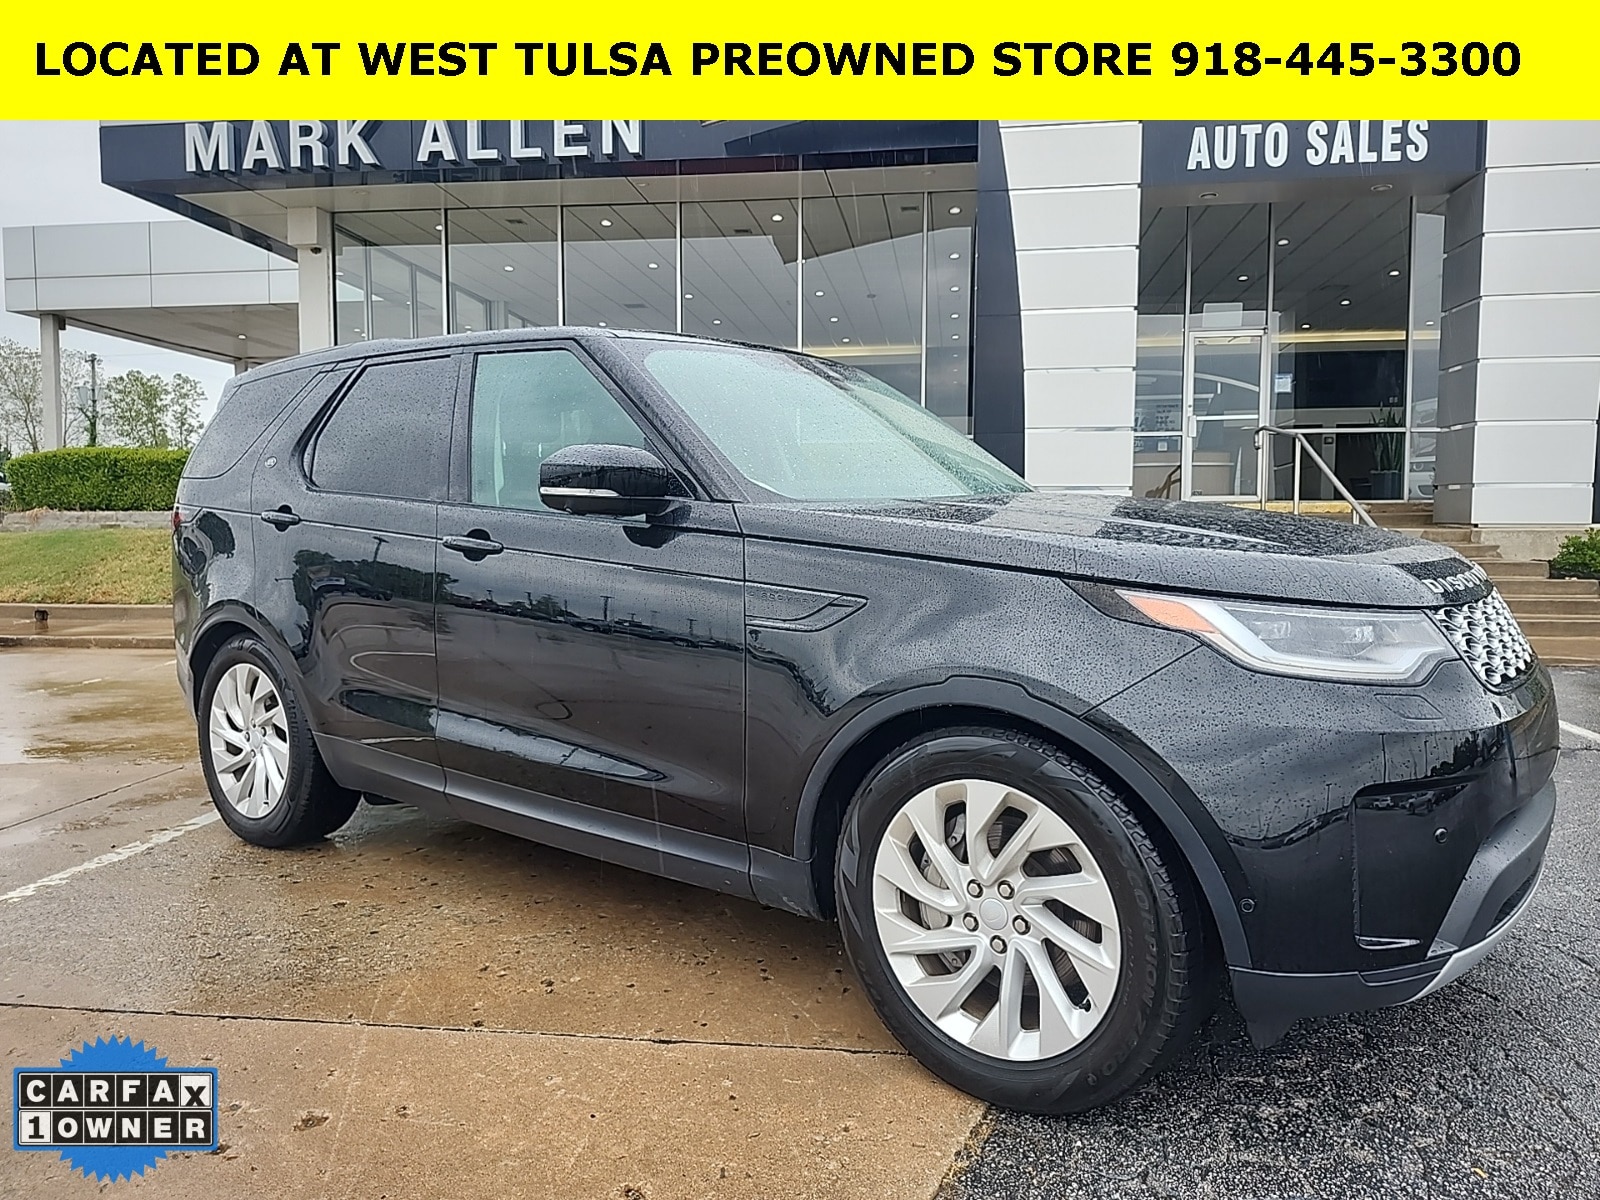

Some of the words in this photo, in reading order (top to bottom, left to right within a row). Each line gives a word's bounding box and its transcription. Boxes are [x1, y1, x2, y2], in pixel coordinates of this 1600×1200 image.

[184, 120, 381, 173] MARK
[416, 120, 643, 162] ALLEN
[1187, 122, 1289, 170] AUTO
[1306, 120, 1430, 166] SALES
